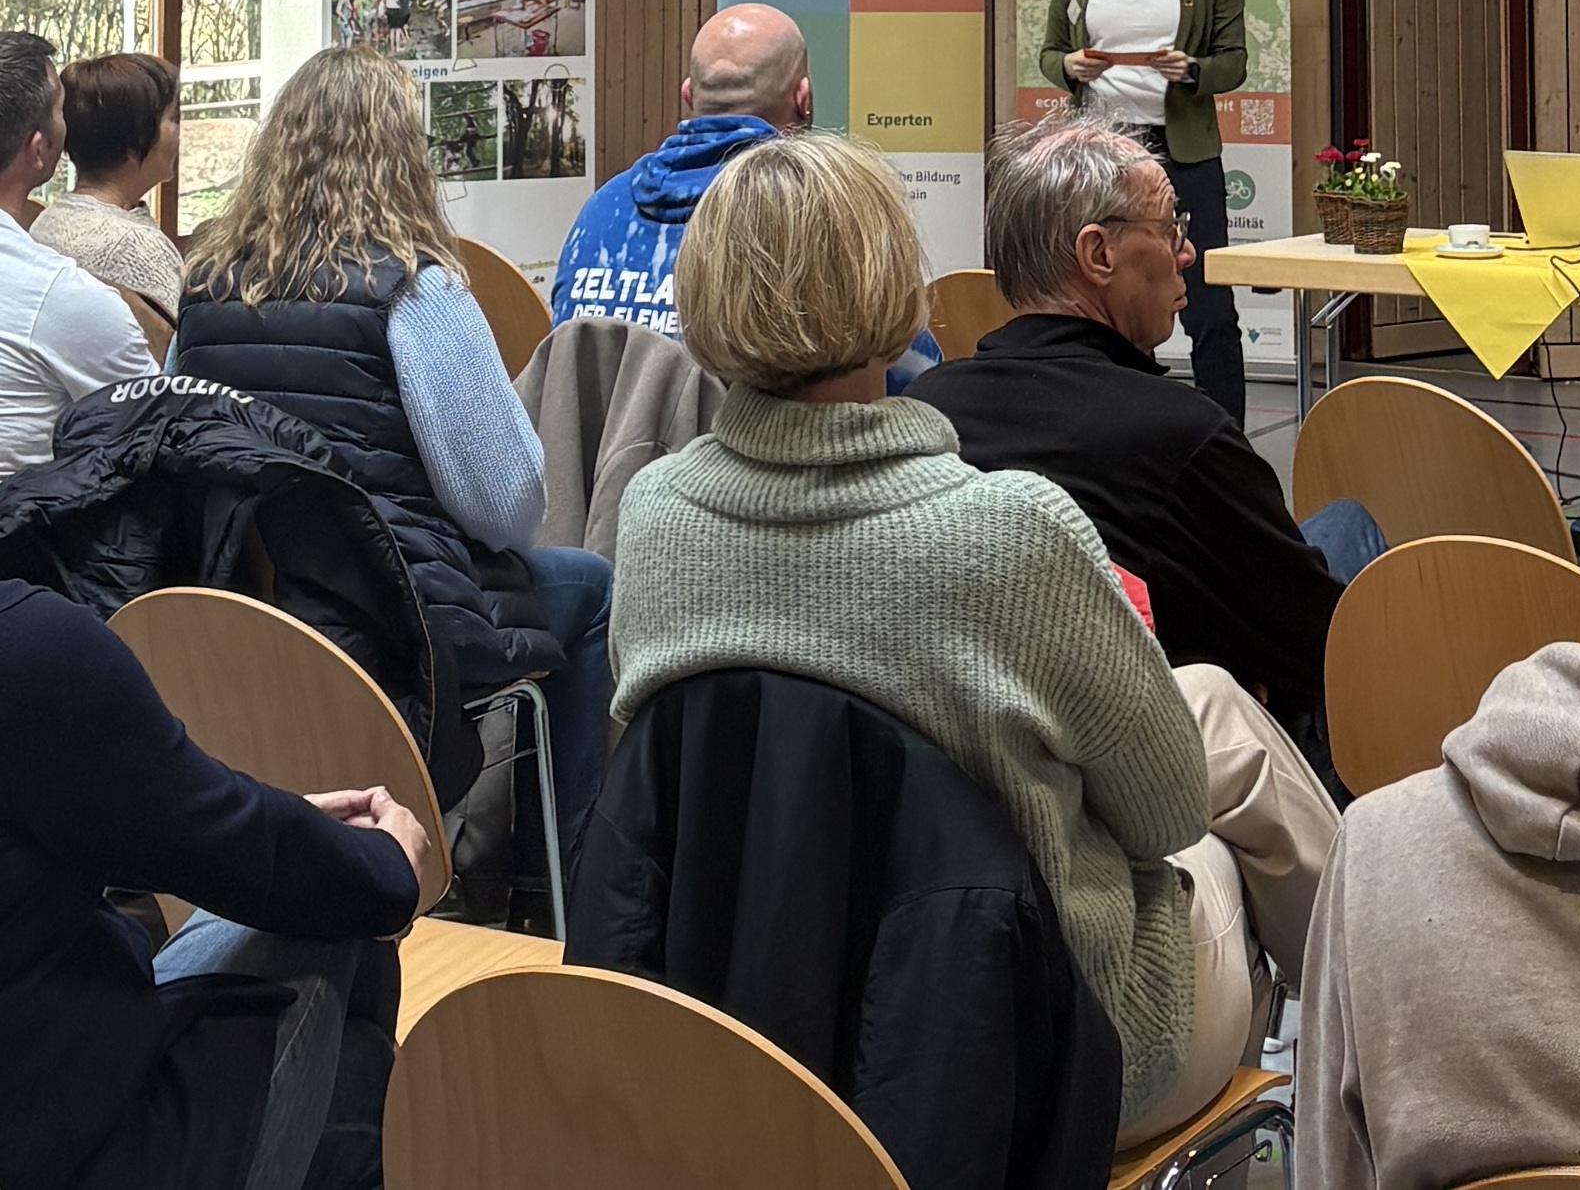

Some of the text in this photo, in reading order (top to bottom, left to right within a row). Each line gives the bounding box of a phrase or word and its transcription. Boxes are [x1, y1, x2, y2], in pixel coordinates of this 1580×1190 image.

[411, 65, 448, 80] eigen
[867, 113, 932, 128] Experten
[916, 171, 961, 185] Bildung
[909, 189, 927, 200] ain
[1227, 215, 1265, 230] bilität
[570, 267, 674, 305] ZELTLA
[613, 306, 681, 333] ELEME
